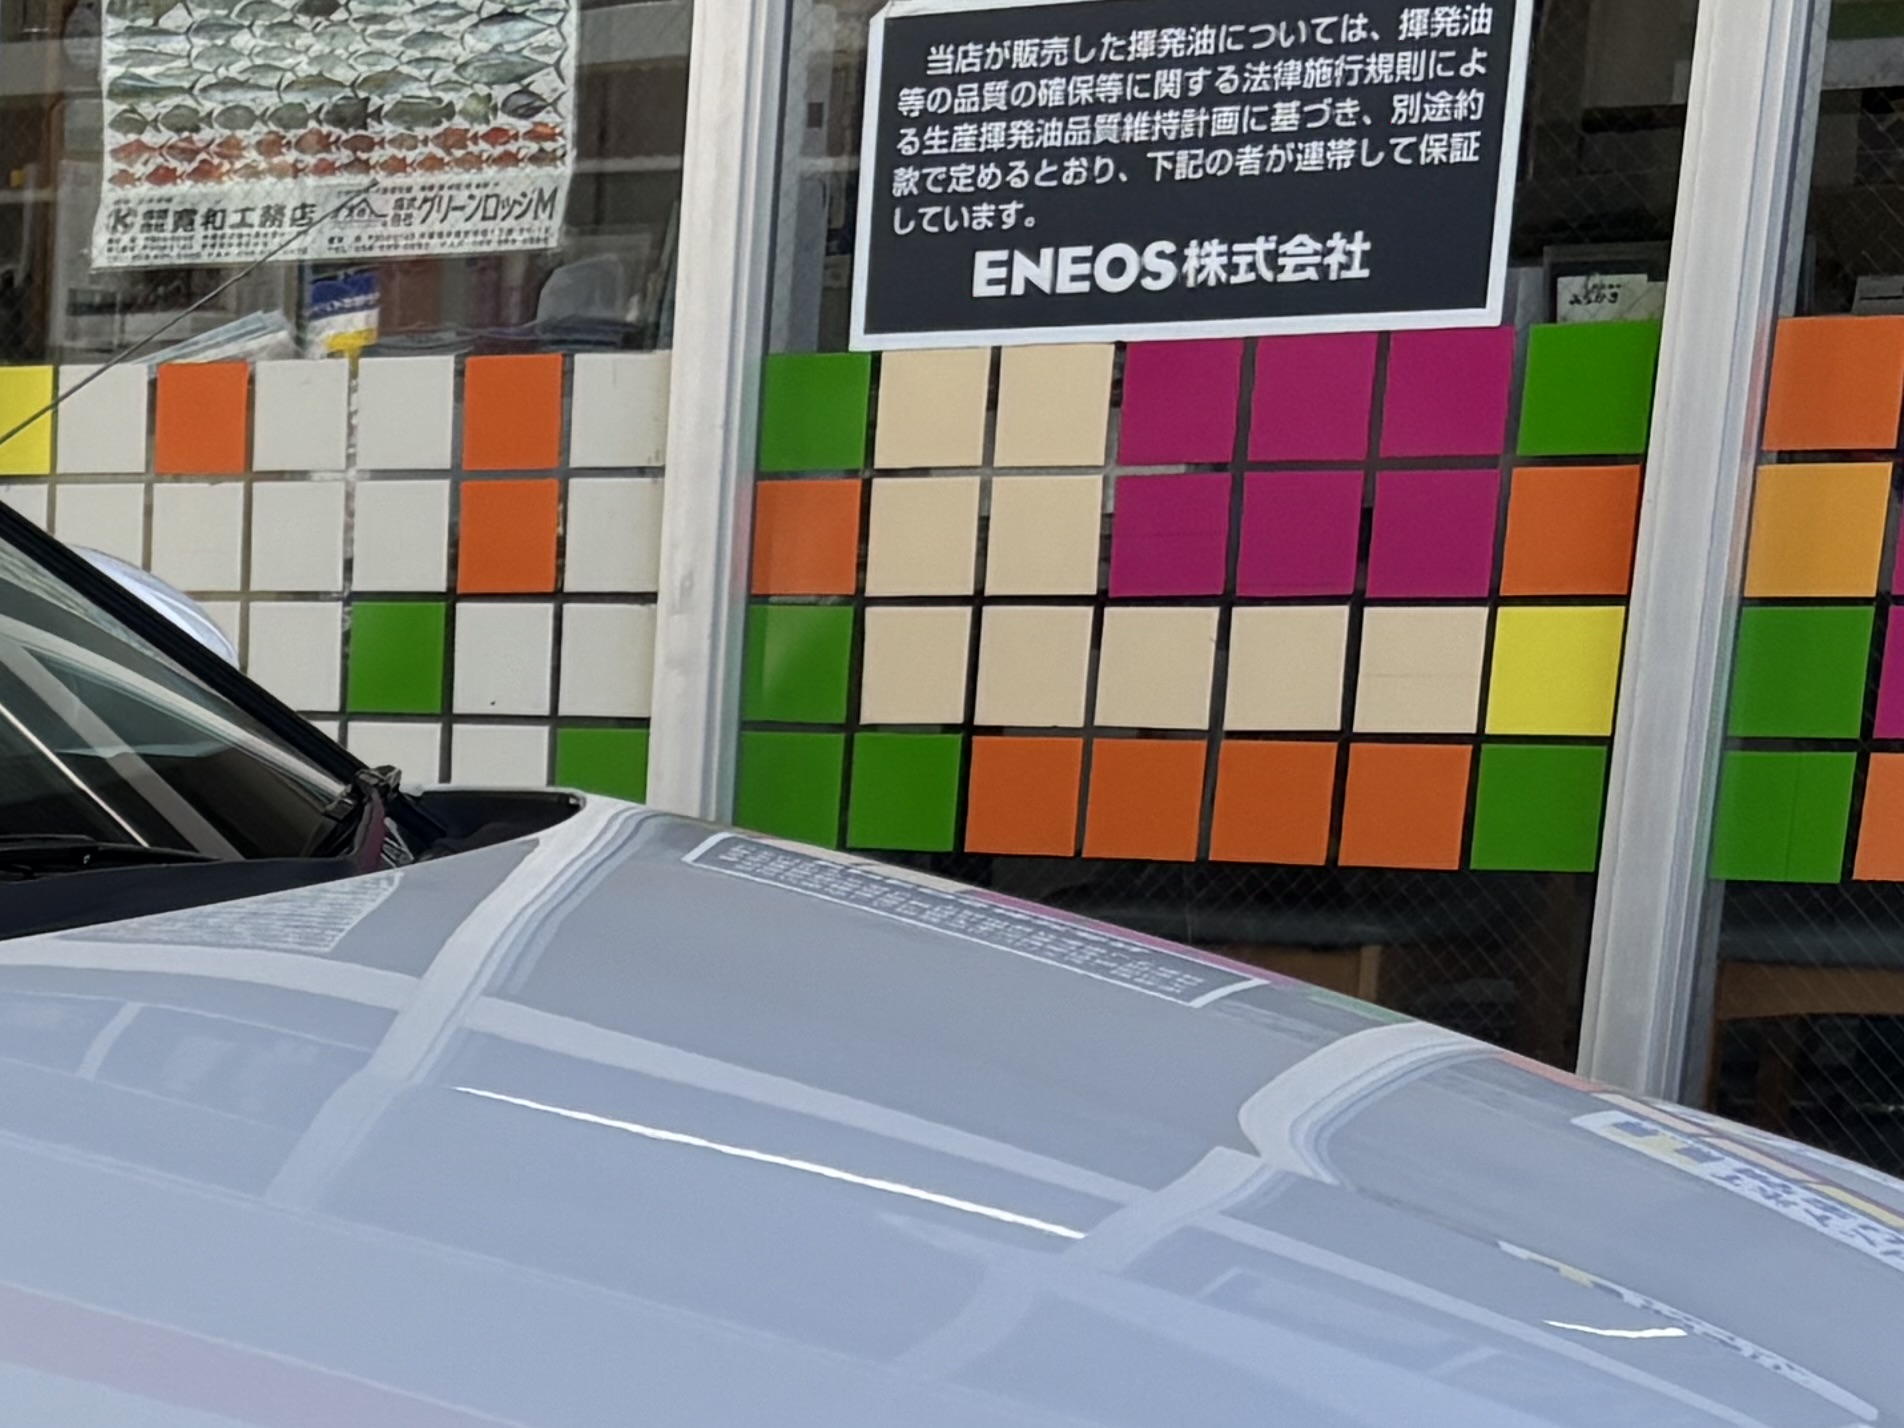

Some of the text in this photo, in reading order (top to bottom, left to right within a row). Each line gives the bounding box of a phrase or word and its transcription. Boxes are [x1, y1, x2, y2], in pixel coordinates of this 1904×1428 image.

[926, 2, 1493, 76] 当店が販売した揮発油については、揮発油
[897, 47, 1488, 117] 等の品質の確保等に関する法律施行規則によ
[896, 88, 1485, 156] る生産揮発油品質維持計画に基づき、別途約
[892, 131, 1482, 198] 款で定めるとおり、下記の者が連帯して保証
[893, 201, 1036, 234] しています。
